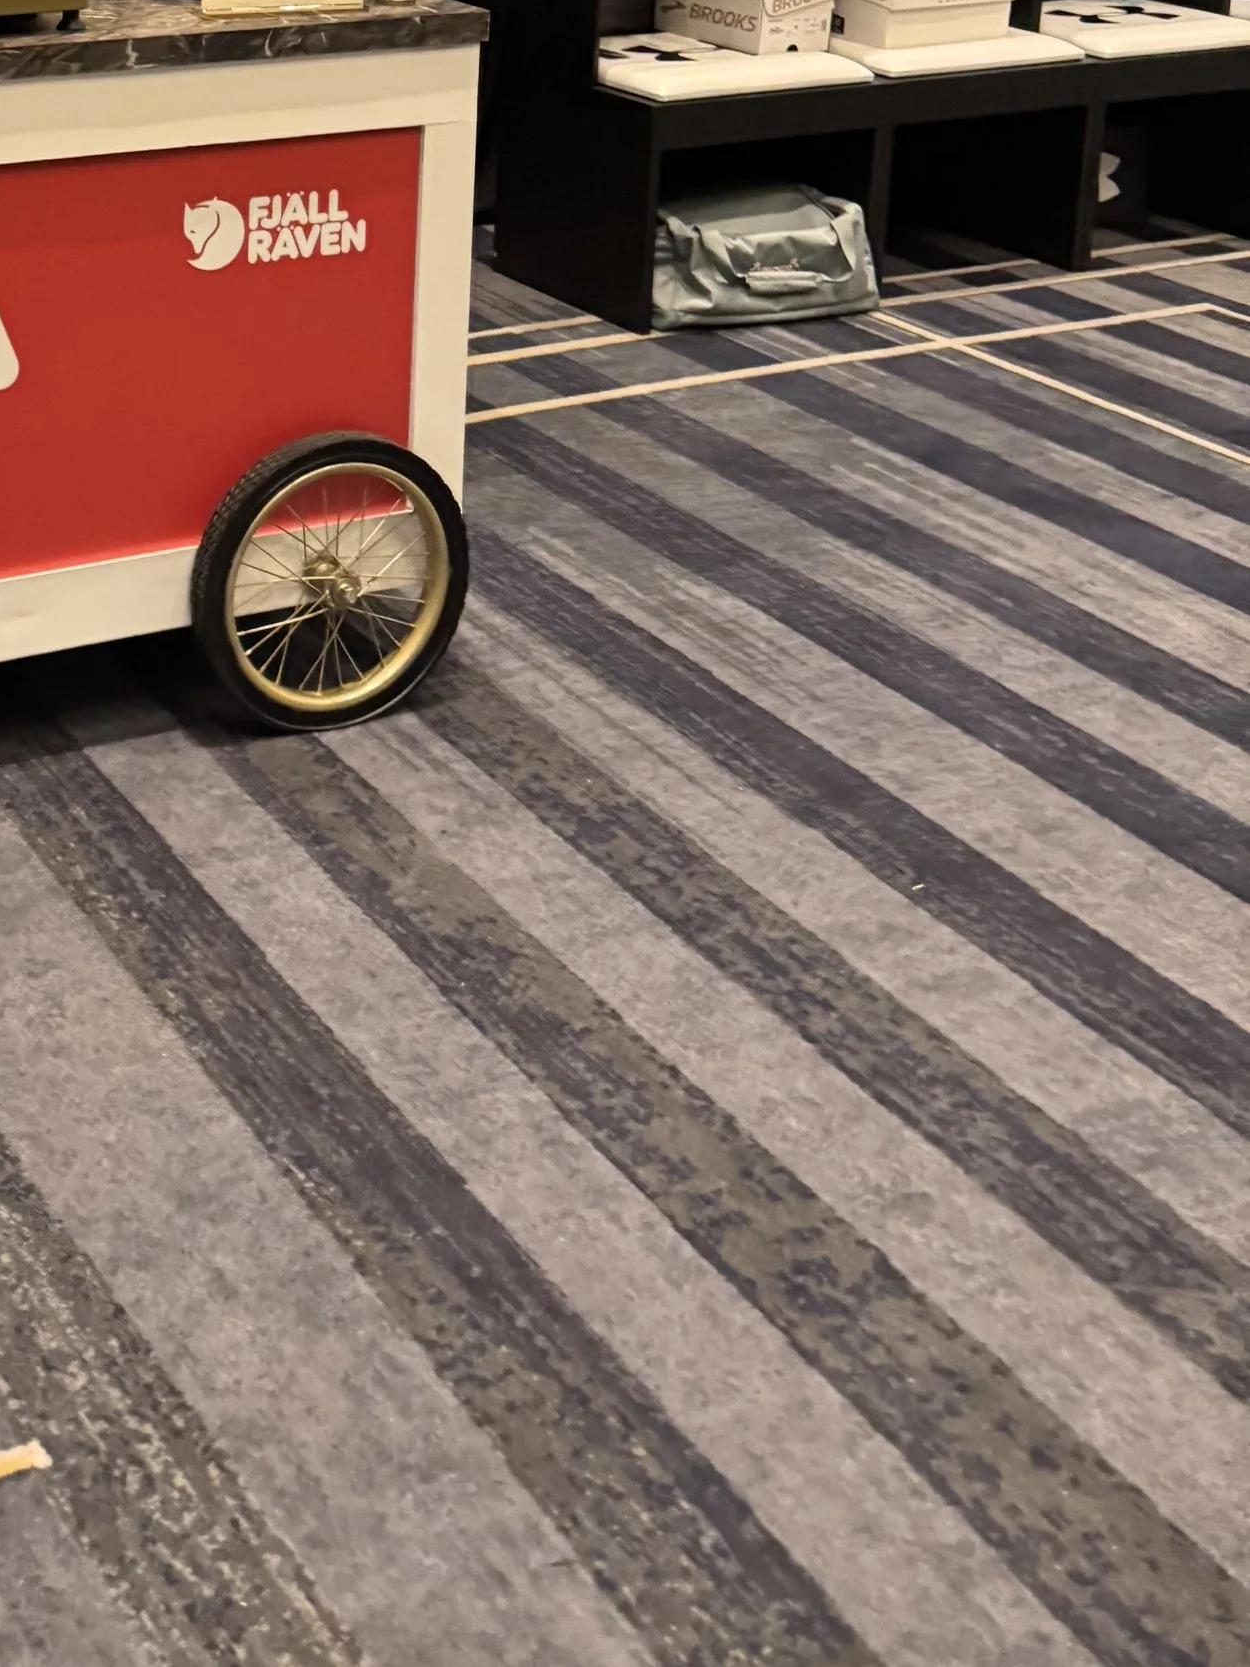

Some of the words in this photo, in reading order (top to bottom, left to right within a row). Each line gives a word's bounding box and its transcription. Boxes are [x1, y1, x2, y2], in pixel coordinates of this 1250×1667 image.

[689, 3, 758, 32] BROOKS
[249, 189, 348, 230] FJÄLL
[248, 219, 366, 264] RÄVEN
